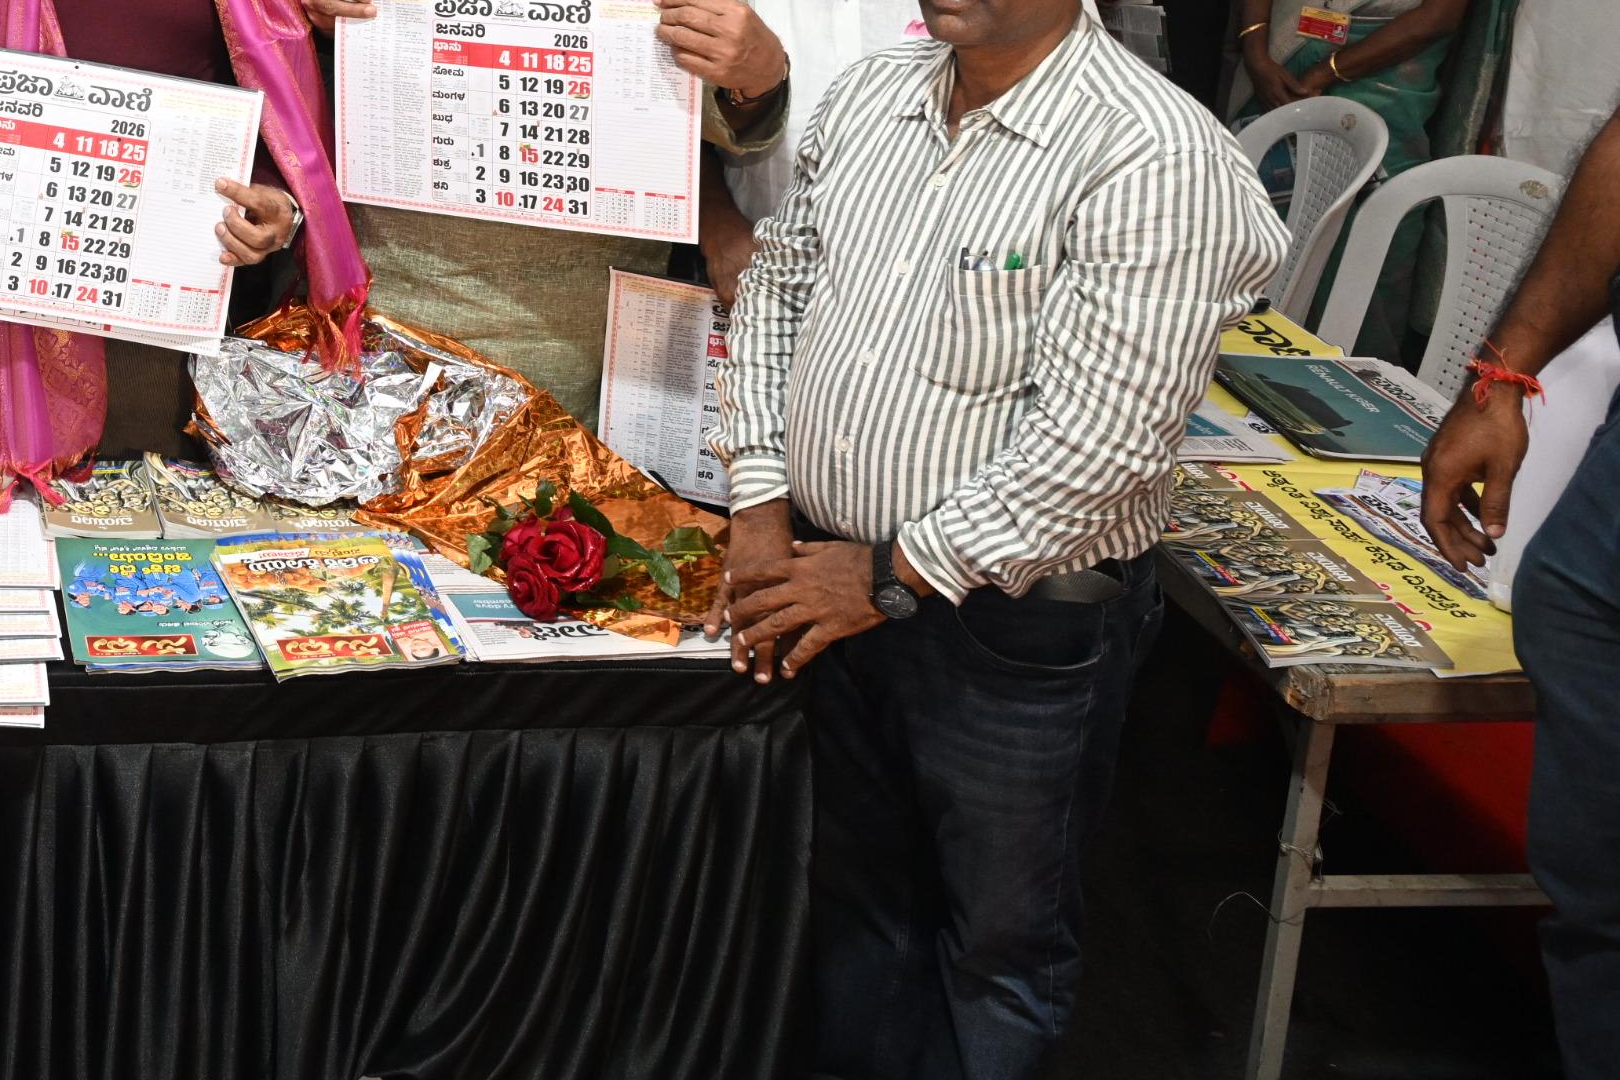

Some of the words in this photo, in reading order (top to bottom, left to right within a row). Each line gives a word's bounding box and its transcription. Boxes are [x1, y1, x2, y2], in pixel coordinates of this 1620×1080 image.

[528, 0, 591, 24] ವಾಣಿ
[436, 23, 485, 37] ಜನವರಿ
[554, 34, 587, 49] 2026
[434, 40, 461, 52] ಭಾನು
[499, 50, 510, 66] 4
[522, 52, 538, 68] 11
[544, 54, 564, 70] 18
[568, 56, 591, 72] 25
[433, 66, 463, 76] ಸೋಮ
[500, 75, 509, 90] 5
[520, 77, 538, 92] 12
[544, 79, 563, 94] 19
[568, 81, 590, 97] 26
[89, 86, 152, 111] ವಾಣಿ
[433, 91, 465, 100] ಮಂಗಳ
[500, 99, 509, 113] 6
[520, 101, 538, 116] 13
[543, 103, 564, 118] 20
[570, 106, 588, 120] 27
[110, 120, 145, 137] 2026
[433, 114, 452, 123] ಬುಧ
[500, 122, 508, 136] 7
[520, 124, 539, 139] 14
[545, 127, 562, 142] 21
[568, 129, 589, 144] 28
[433, 136, 454, 145] ಗುರು
[477, 144, 483, 157] 1
[500, 146, 509, 160] 8
[521, 147, 538, 163] 15
[543, 150, 564, 166] 22
[568, 152, 589, 168] 29
[433, 158, 451, 169] ಶುಕ್ರ
[476, 166, 485, 180] 2
[500, 169, 510, 183] 9
[519, 172, 538, 186] 16
[543, 174, 564, 189] 23
[566, 176, 589, 193] 30
[434, 181, 448, 190] ಶನಿ
[476, 189, 486, 203] 3
[496, 192, 514, 206] 10
[522, 195, 537, 209] 17
[543, 197, 564, 212] 24
[569, 200, 587, 215] 31
[1365, 546, 1413, 572] ಕನ್ನಡ
[1402, 575, 1476, 618] ದಿನಪತ್ರಿಕೆ
[92, 636, 189, 654] ಸುಧಾ
[287, 635, 379, 656] ಸುಧಾ
